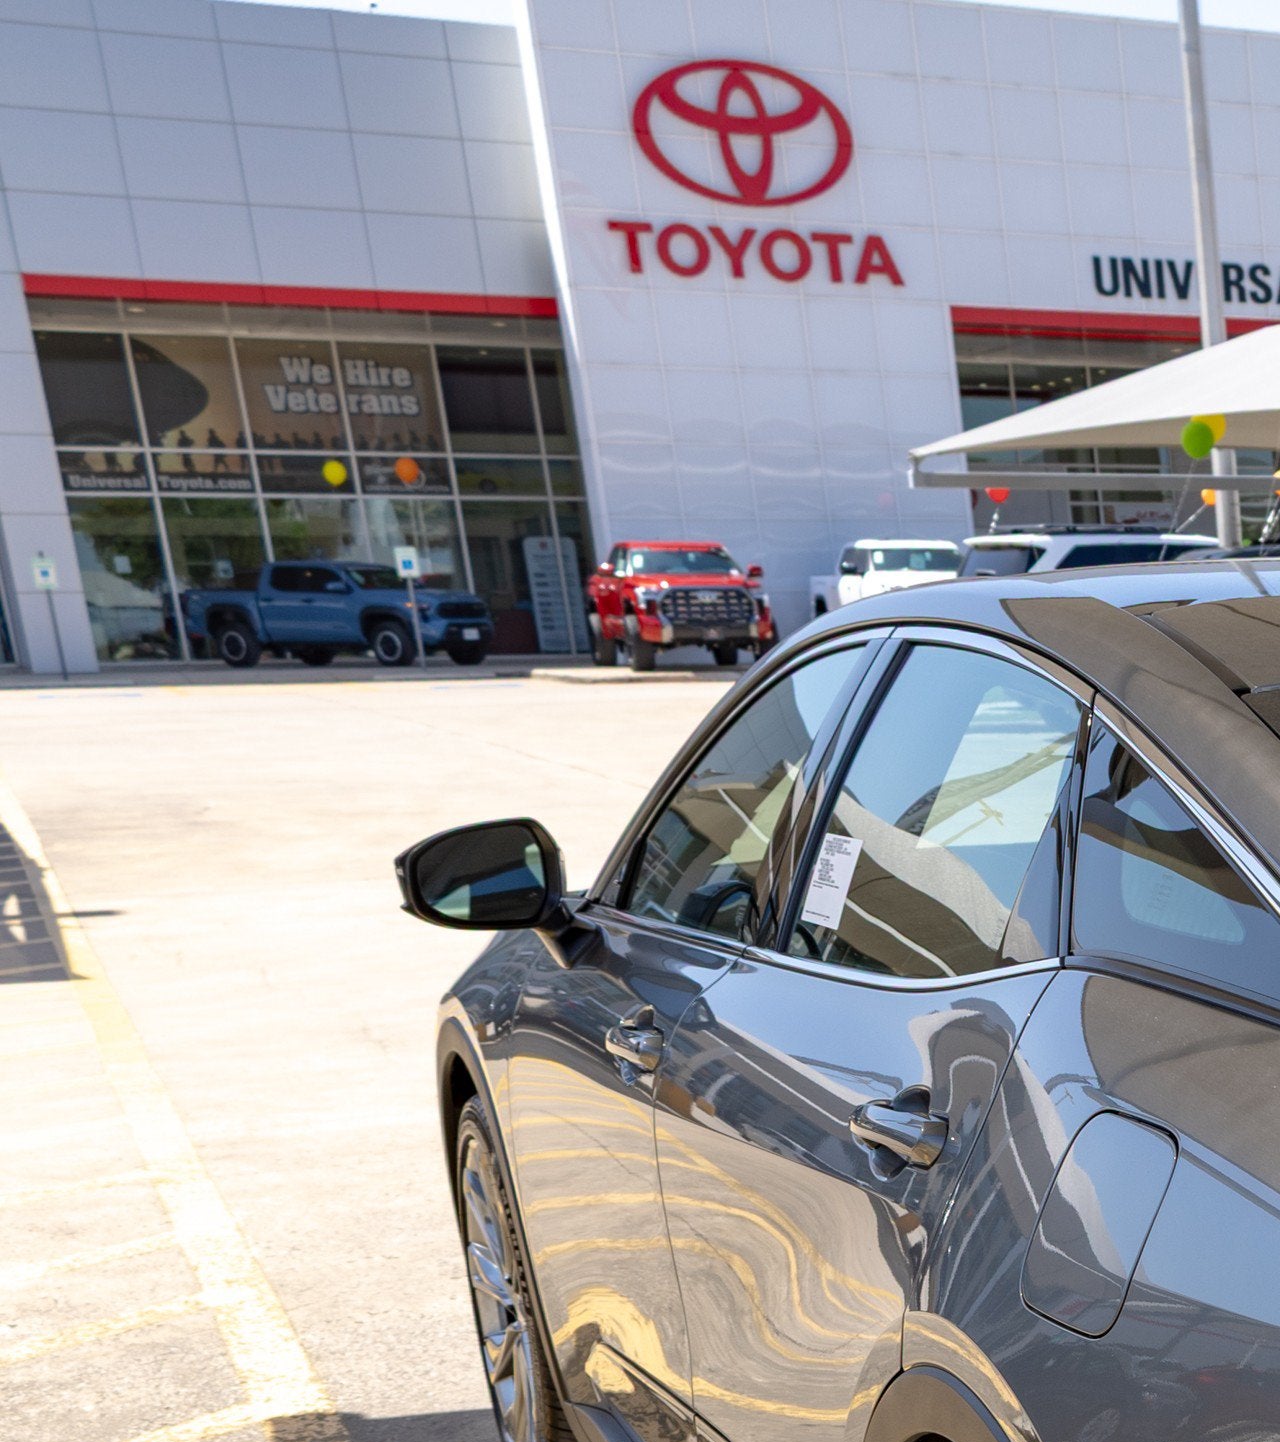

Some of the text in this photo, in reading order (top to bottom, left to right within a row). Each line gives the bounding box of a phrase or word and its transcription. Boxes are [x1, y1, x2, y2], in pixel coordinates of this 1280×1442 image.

[607, 220, 905, 287] TOYOTA
[279, 356, 413, 388] We Hire
[263, 384, 420, 416] Veterans
